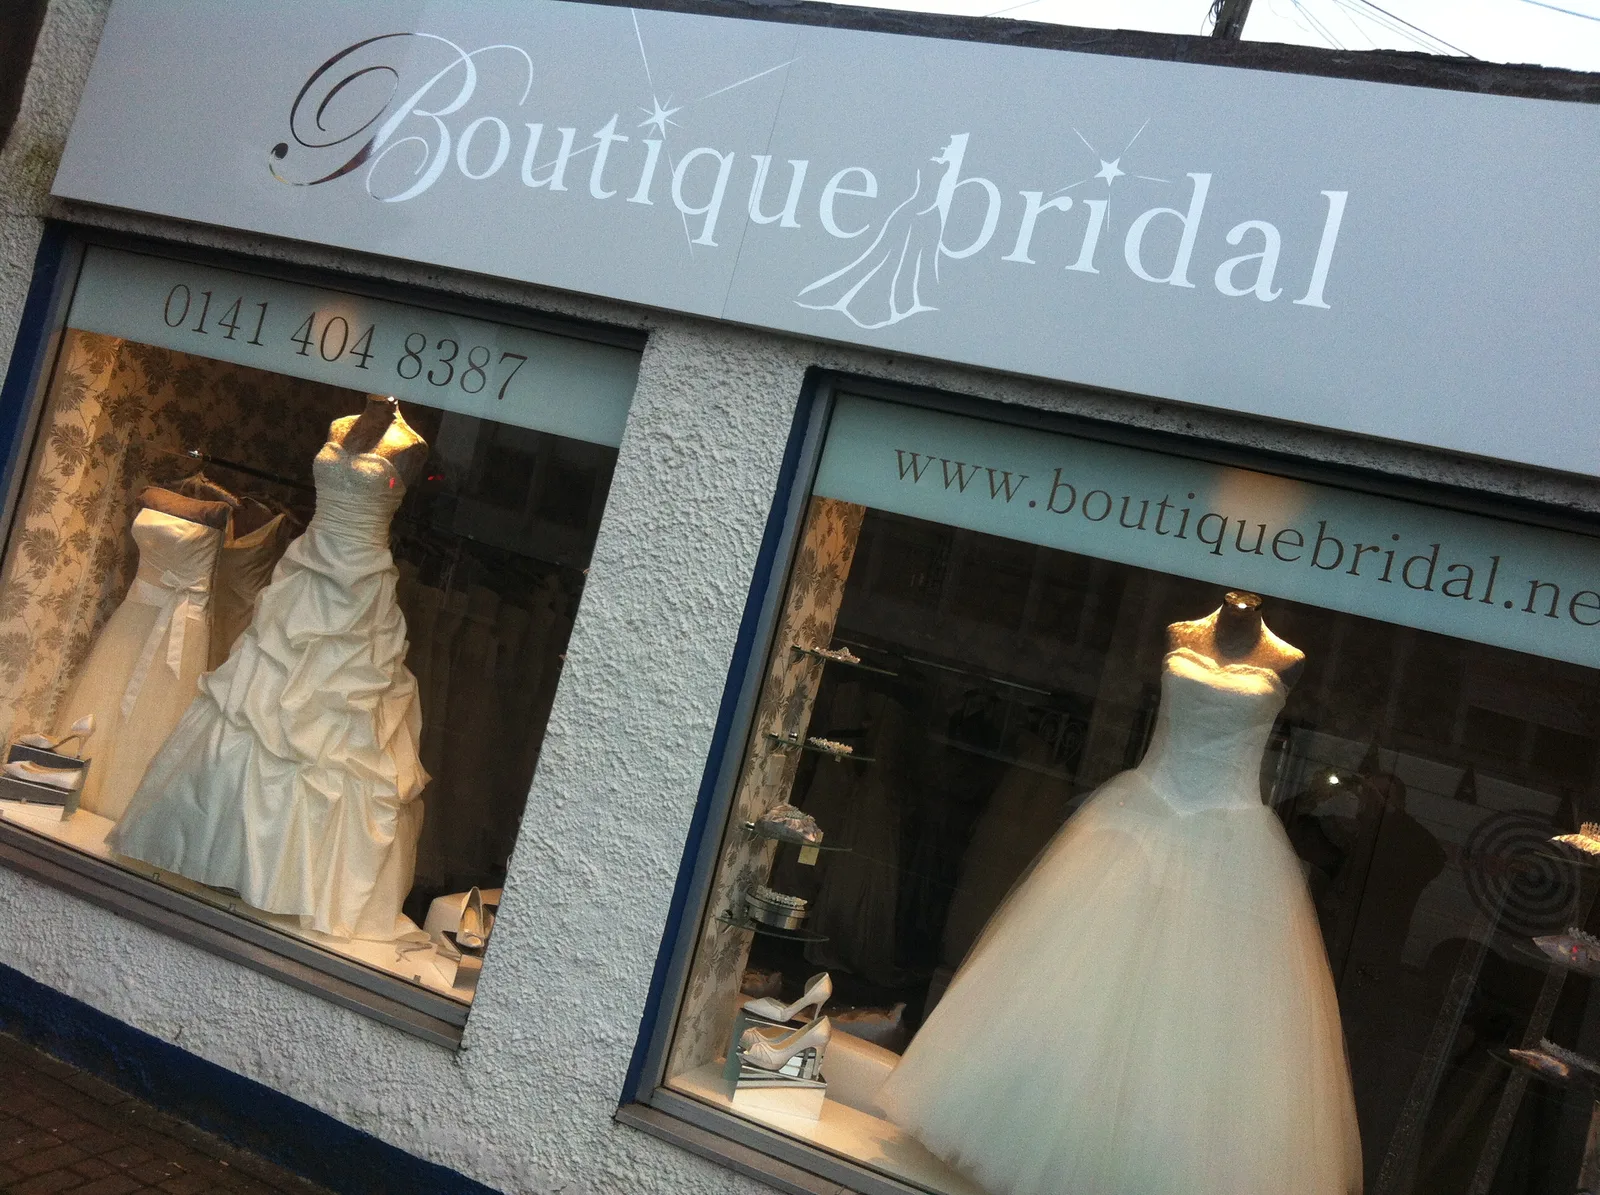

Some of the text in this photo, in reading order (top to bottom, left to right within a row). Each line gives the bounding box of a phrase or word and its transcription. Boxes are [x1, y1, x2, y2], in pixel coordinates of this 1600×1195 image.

[269, 30, 1350, 311] Boutique bridal
[163, 283, 528, 400] 0141 404 8387
